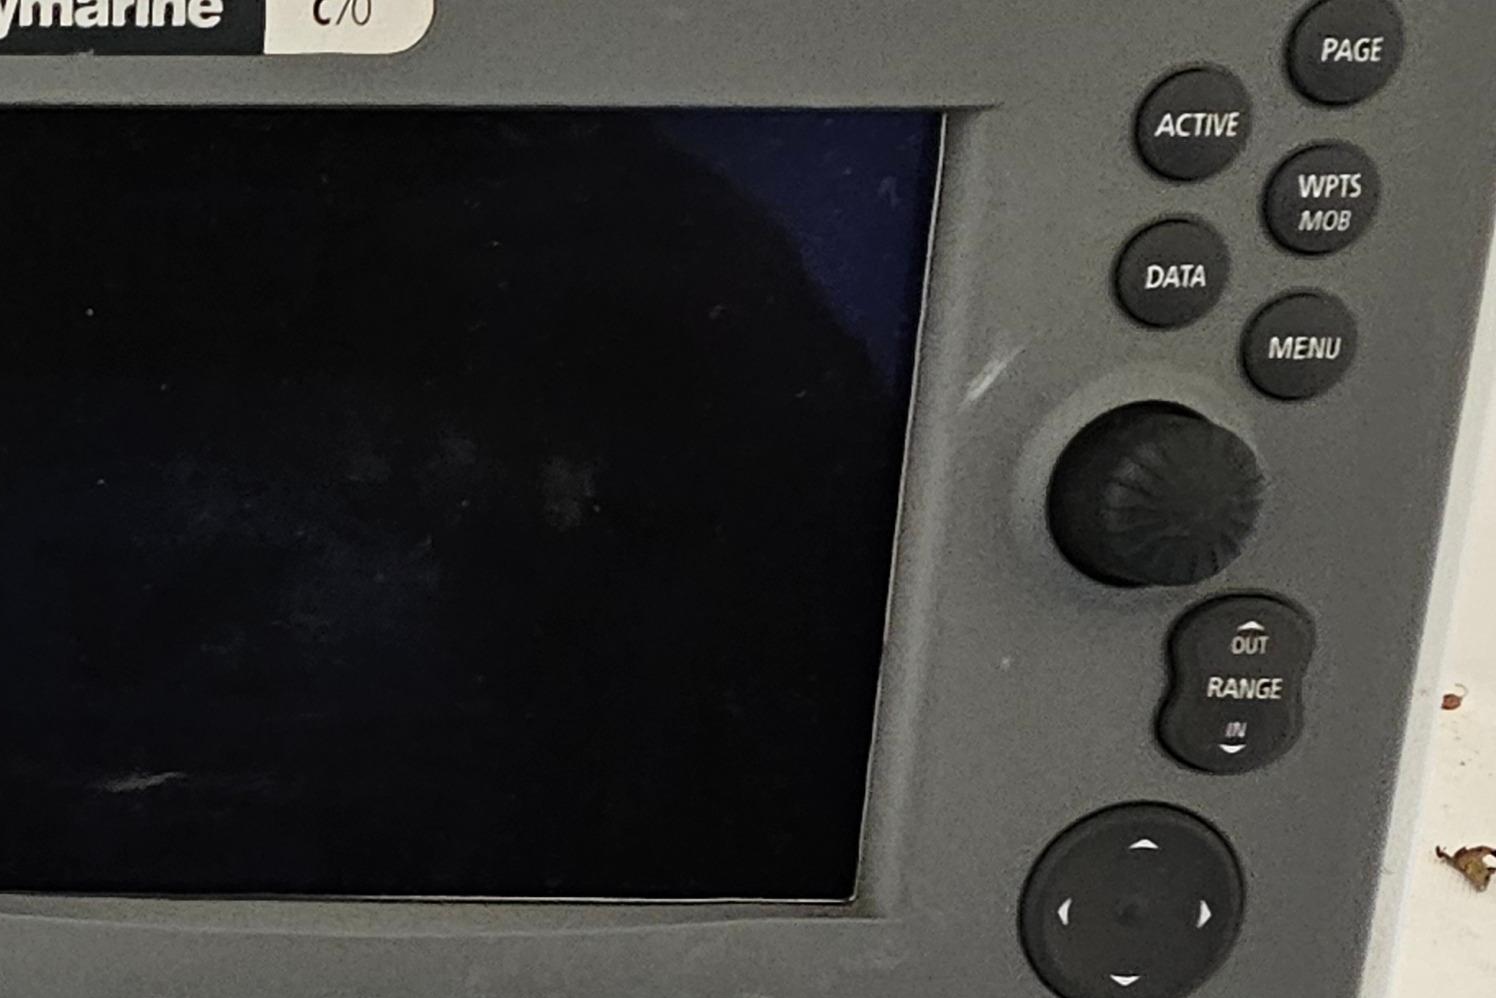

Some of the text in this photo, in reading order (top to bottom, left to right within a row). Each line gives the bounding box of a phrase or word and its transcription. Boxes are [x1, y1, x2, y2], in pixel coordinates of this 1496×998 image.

[1320, 36, 1384, 63] PAGE
[1154, 111, 1240, 138] ACTIVE
[1298, 173, 1362, 199] WPTS
[1298, 209, 1352, 232] MOB
[1144, 263, 1207, 290] DATA
[1267, 335, 1342, 360] MENU
[1231, 635, 1270, 655] OUT
[1206, 676, 1284, 700] RANGE
[1224, 721, 1248, 738] IN
